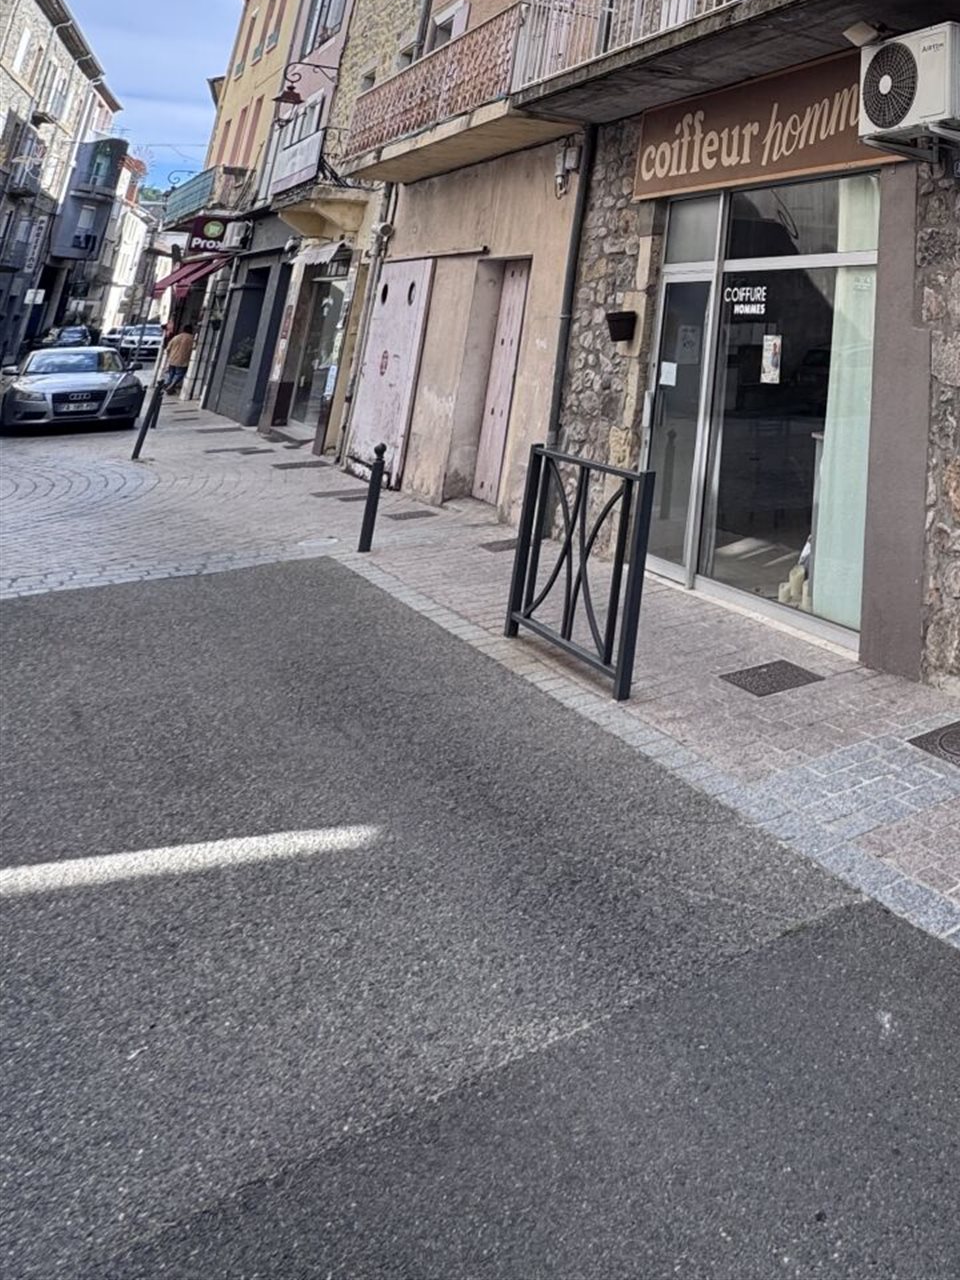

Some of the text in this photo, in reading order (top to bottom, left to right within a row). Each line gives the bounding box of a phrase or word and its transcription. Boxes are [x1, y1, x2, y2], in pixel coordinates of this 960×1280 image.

[640, 83, 860, 181] coiffeur homm
[191, 237, 225, 250] Prox
[723, 286, 767, 302] COIFFURE
[733, 303, 765, 315] HOMMES
